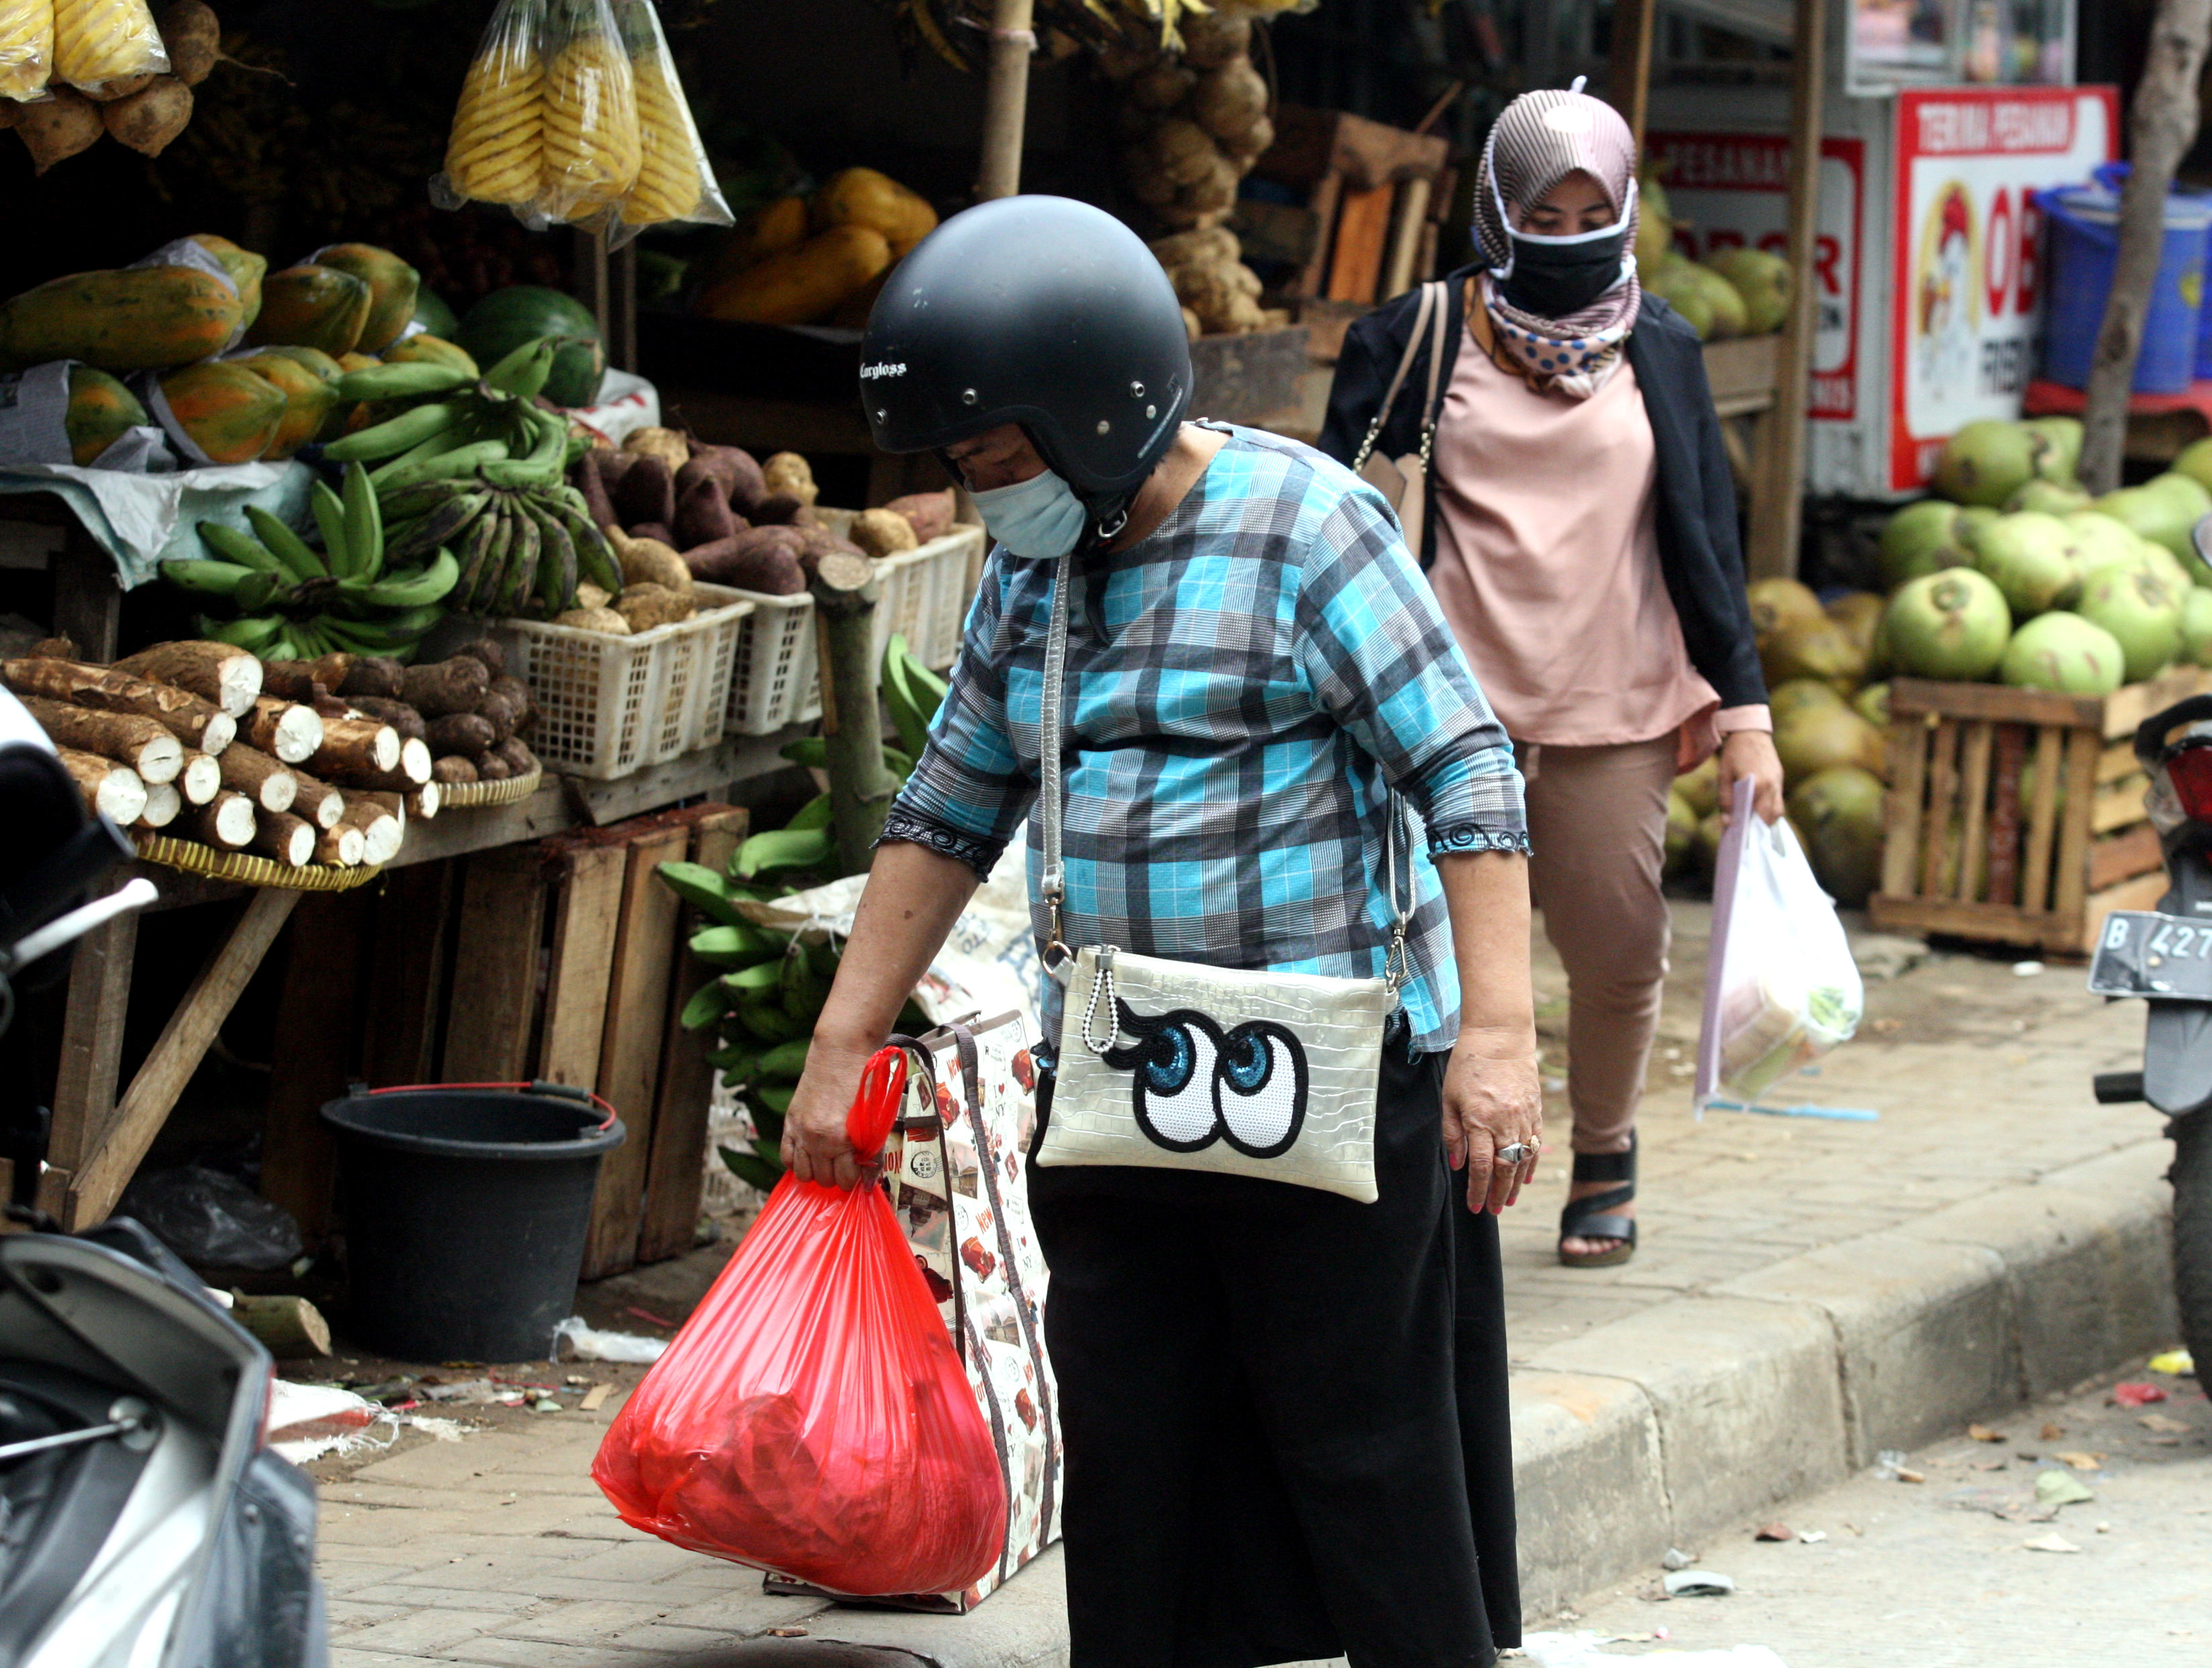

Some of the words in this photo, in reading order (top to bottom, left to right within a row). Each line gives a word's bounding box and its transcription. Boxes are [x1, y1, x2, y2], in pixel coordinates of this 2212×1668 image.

[2105, 918, 2129, 950] B
[947, 1054, 962, 1081] New
[975, 1206, 994, 1234] New
